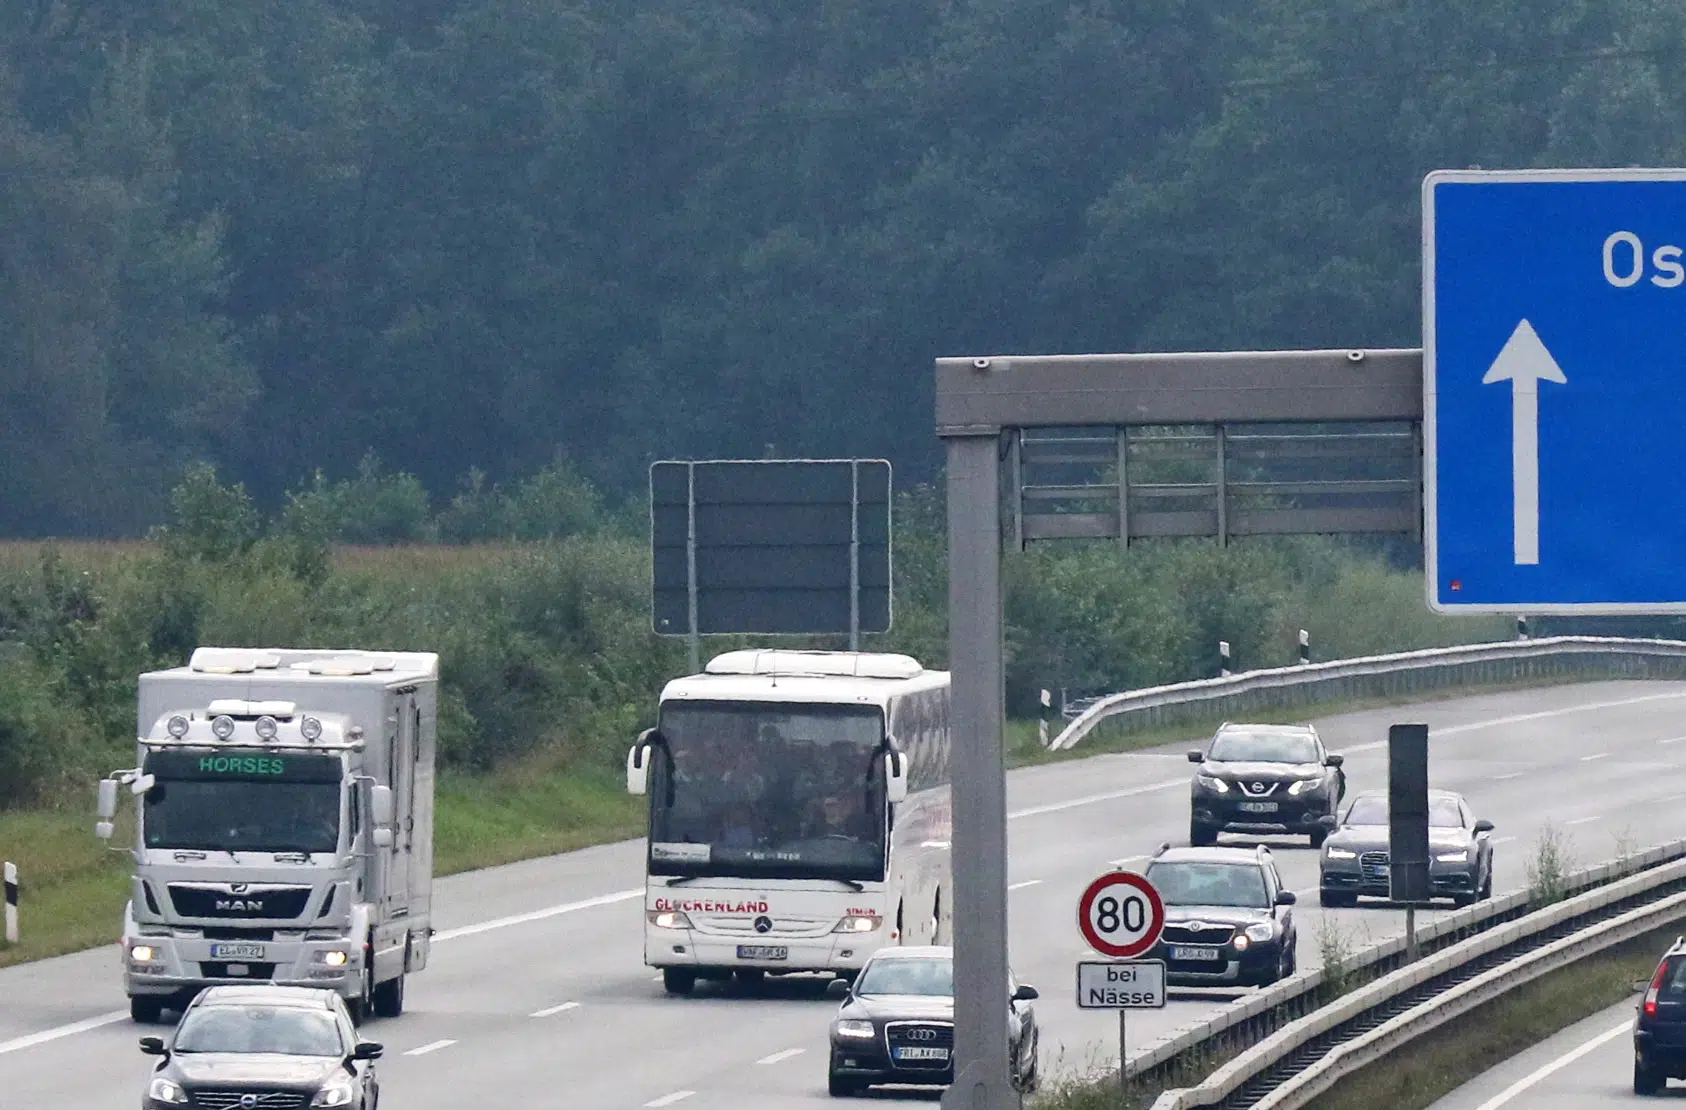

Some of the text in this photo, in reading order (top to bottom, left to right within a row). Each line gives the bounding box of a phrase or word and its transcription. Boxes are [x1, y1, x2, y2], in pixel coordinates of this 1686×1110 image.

[200, 757, 284, 774] HORSES
[216, 900, 263, 911] MAN
[1096, 895, 1145, 934] 80
[1107, 966, 1136, 982] bei
[1090, 988, 1155, 1004] Nässe
